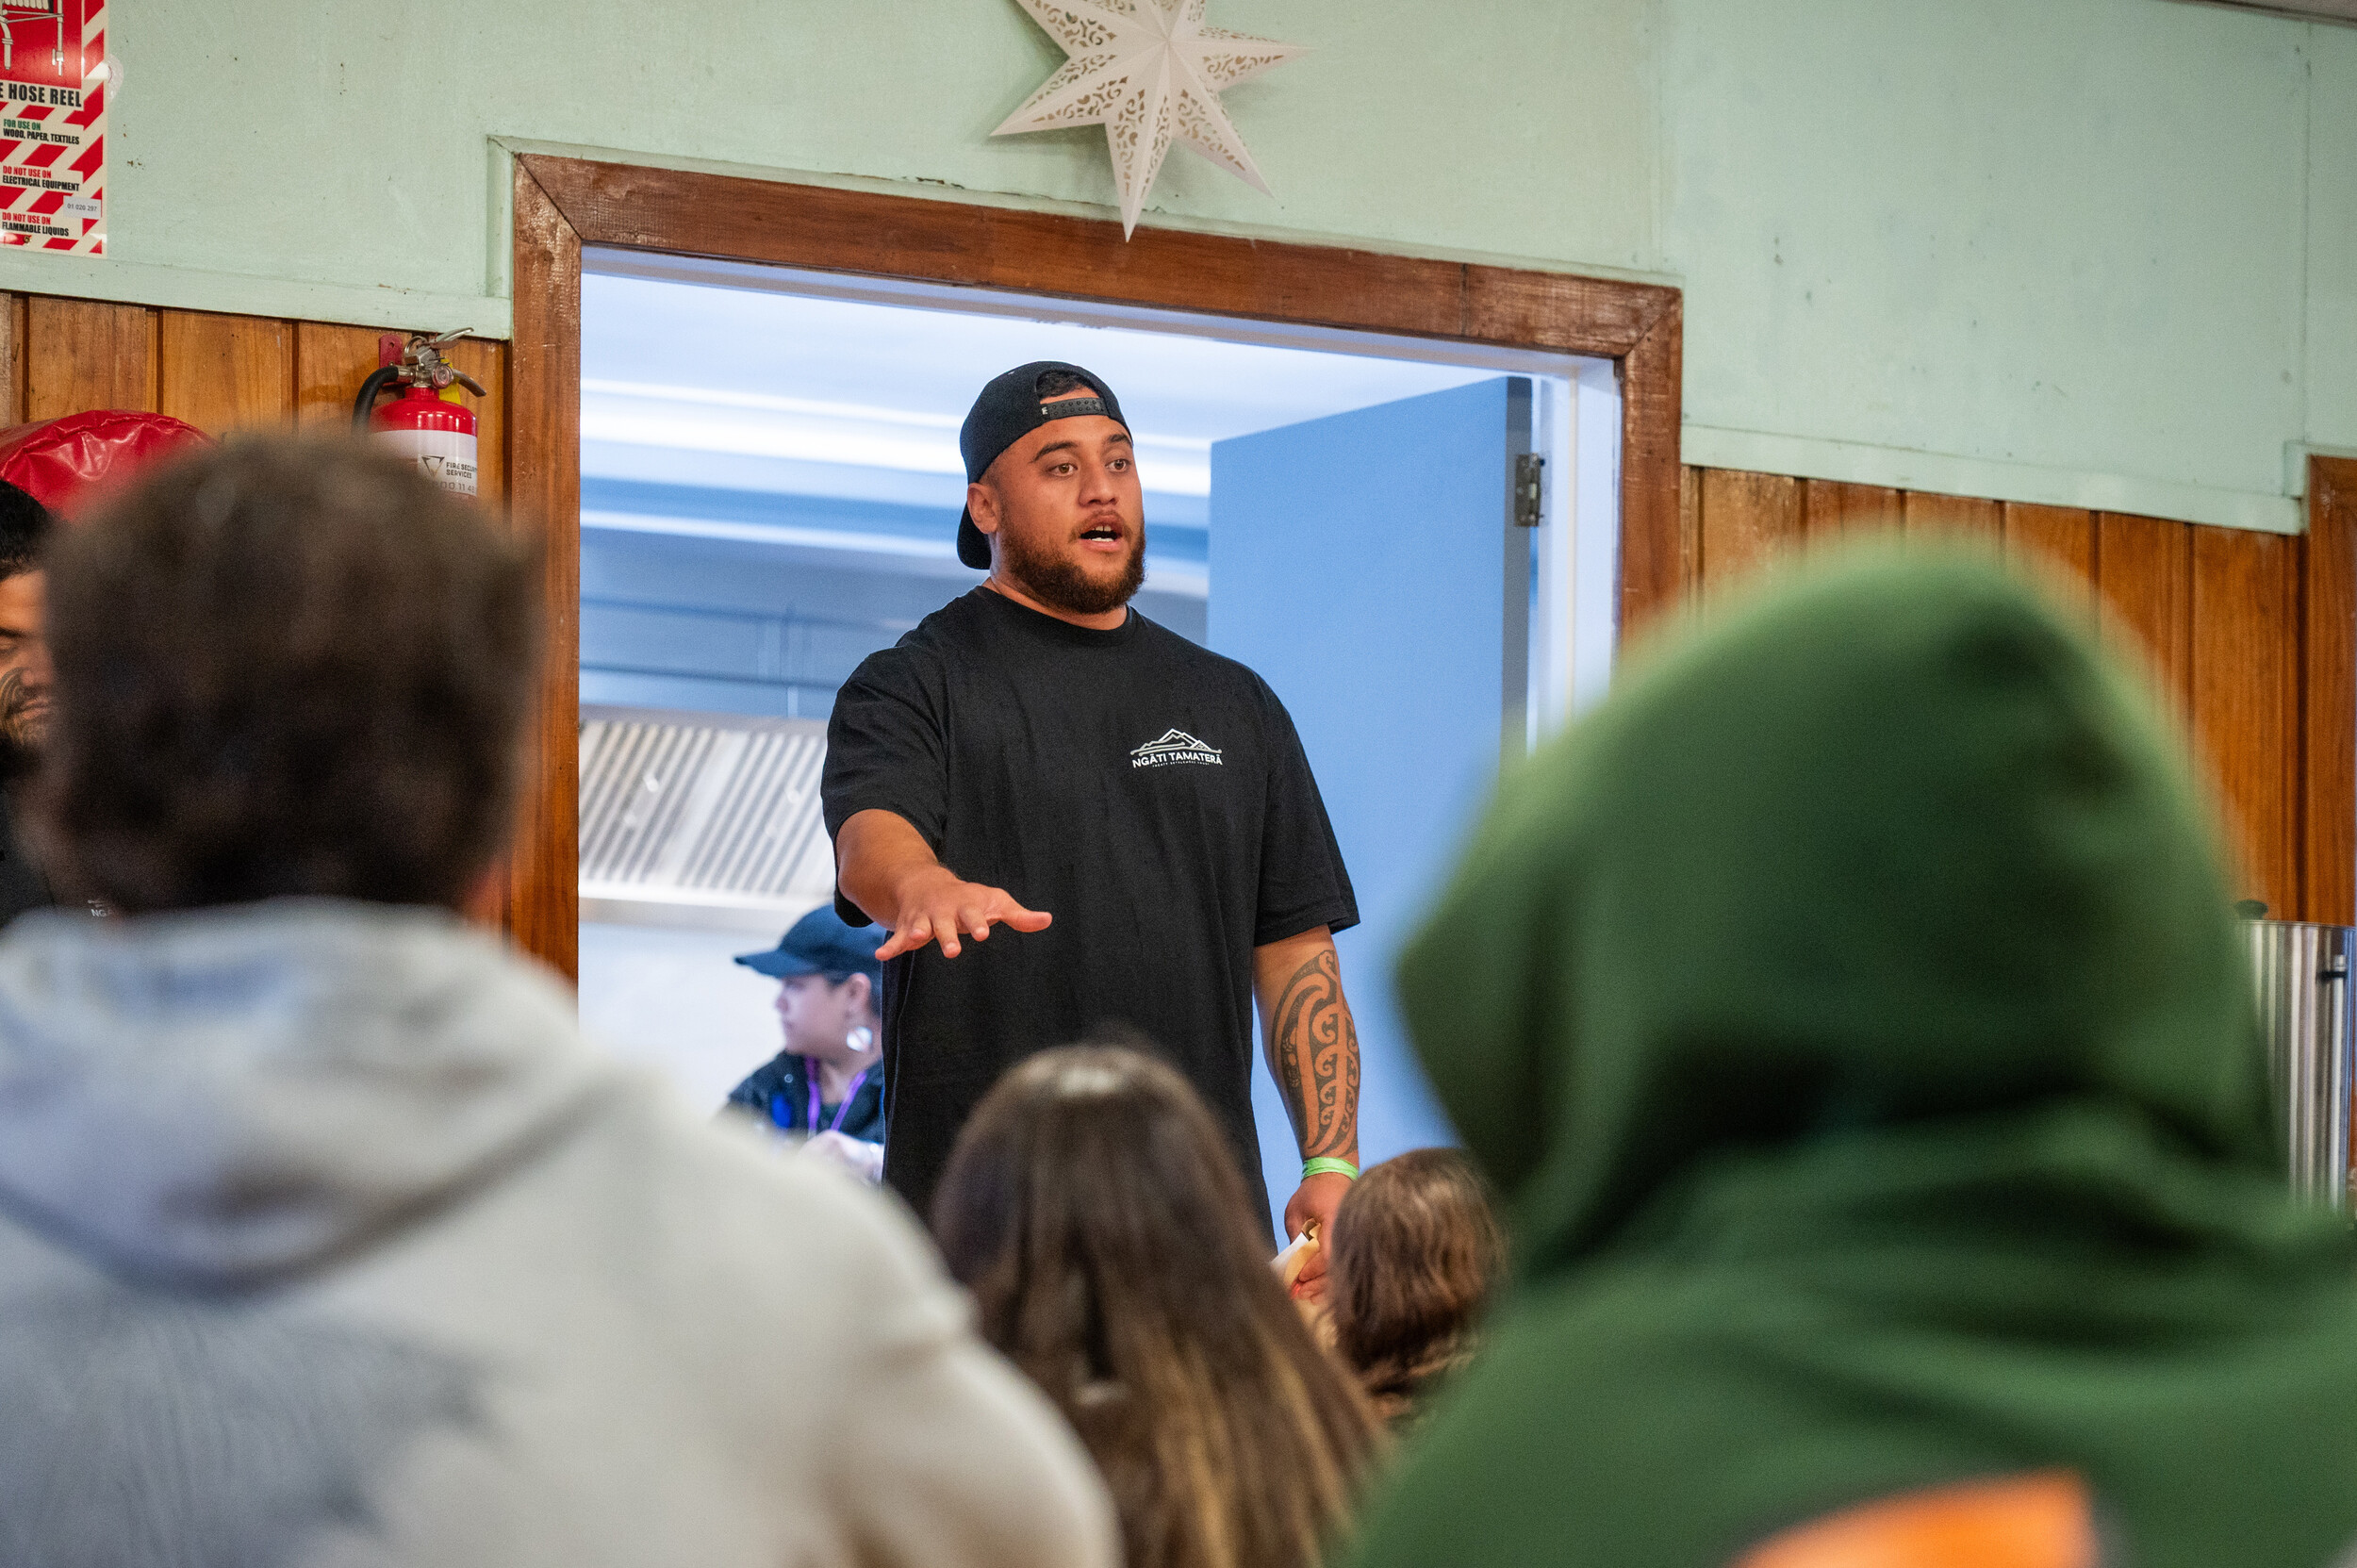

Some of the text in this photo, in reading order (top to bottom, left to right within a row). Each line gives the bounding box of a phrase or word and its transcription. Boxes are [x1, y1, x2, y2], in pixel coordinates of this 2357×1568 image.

[8, 83, 45, 103] HOSE
[50, 88, 82, 107] REEL
[3, 119, 41, 131] FOR USE ON
[3, 128, 80, 145] WOOD, PAPER, TEXTILES
[3, 165, 52, 179] DO NOT USE ON
[2, 174, 80, 191] ELECTRICAL EQUIPMENT
[2, 211, 51, 225] DO NOT USE ON
[2, 221, 70, 237] FLAMMABLE LIQUIDS
[446, 461, 460, 470] FIRE
[446, 469, 472, 479] SERVICES
[1131, 752, 1167, 768] NGĀTI
[1168, 751, 1223, 766] TAMATERĀ
